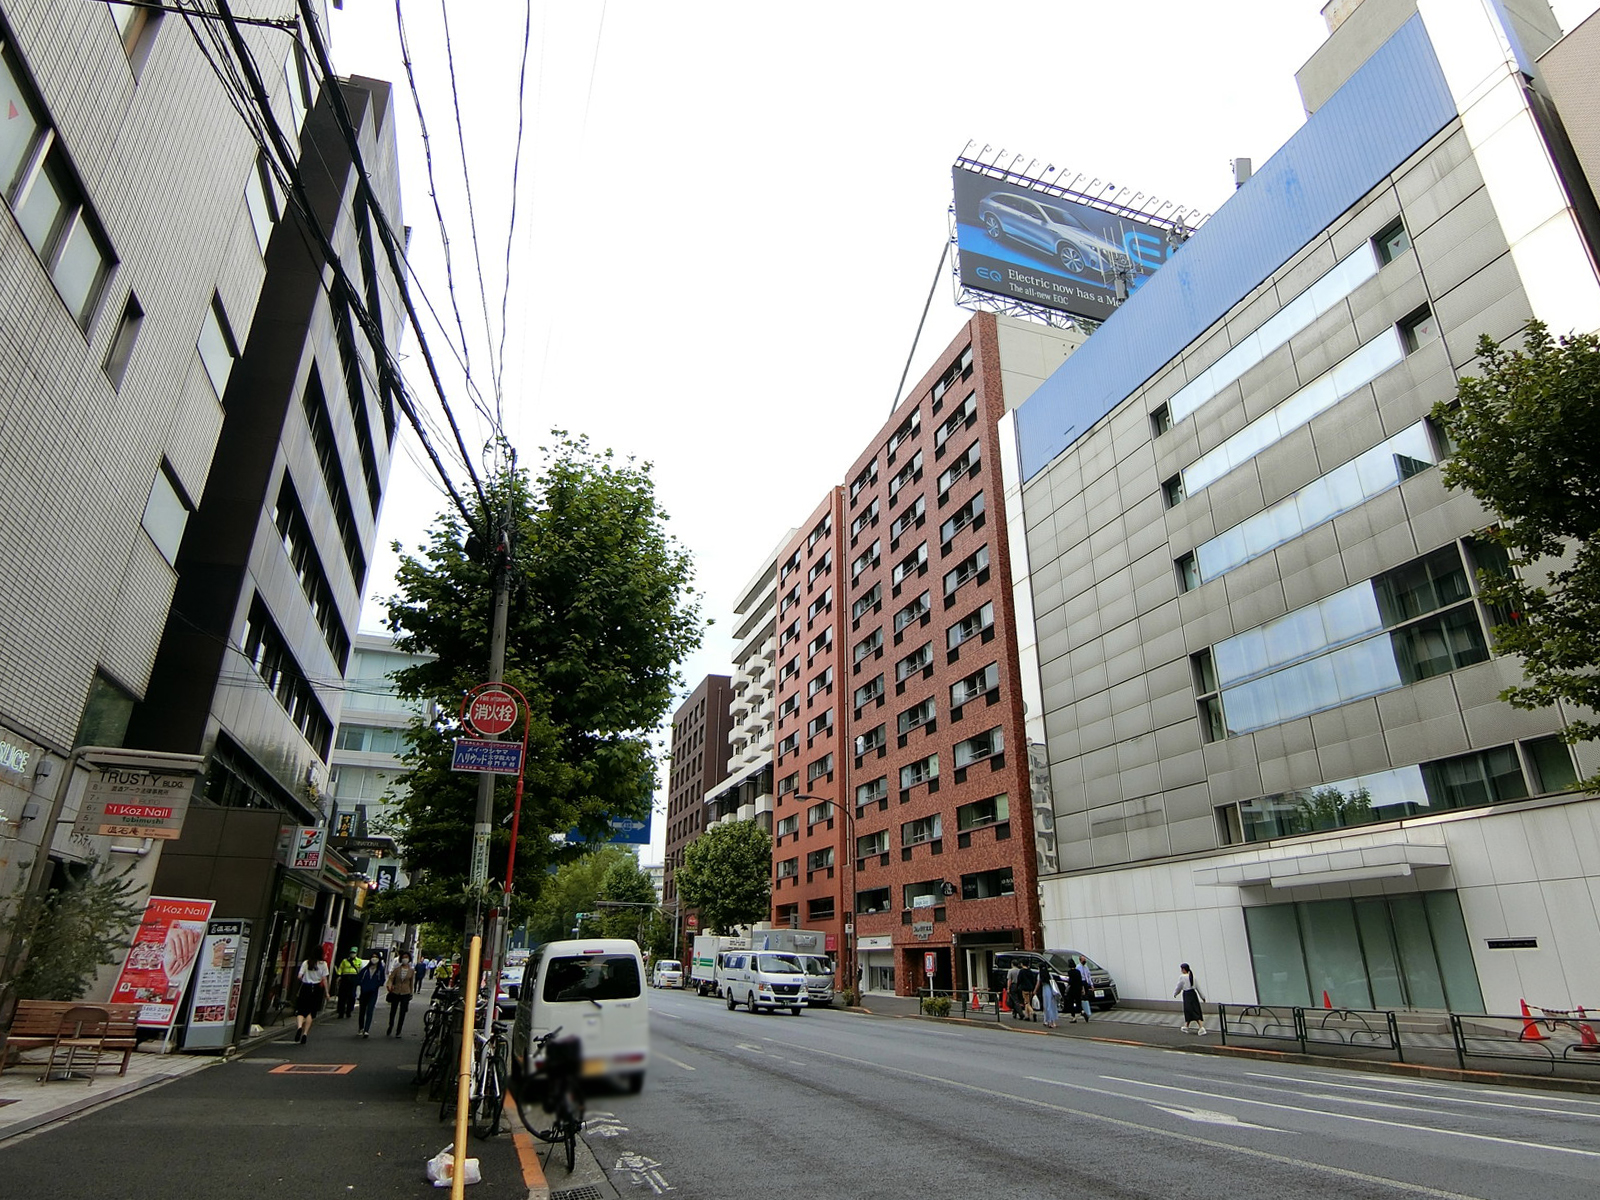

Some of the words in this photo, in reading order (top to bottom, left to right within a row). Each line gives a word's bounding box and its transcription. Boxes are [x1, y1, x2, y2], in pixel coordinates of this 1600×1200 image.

[976, 267, 1001, 282] EQ
[1008, 269, 1051, 289] Electric
[1052, 283, 1073, 295] now
[1076, 287, 1095, 301] has
[1097, 295, 1104, 303] a
[1009, 282, 1023, 293] The
[1024, 287, 1050, 300] all-new
[1053, 294, 1068, 305] EQC
[474, 703, 513, 722] 消火栓
[0, 740, 29, 773] SLICE
[100, 770, 161, 786] TRUSTY
[120, 805, 141, 814] Koz
[144, 807, 168, 817] Nail
[162, 905, 182, 914] Koz
[184, 907, 206, 915] Nail
